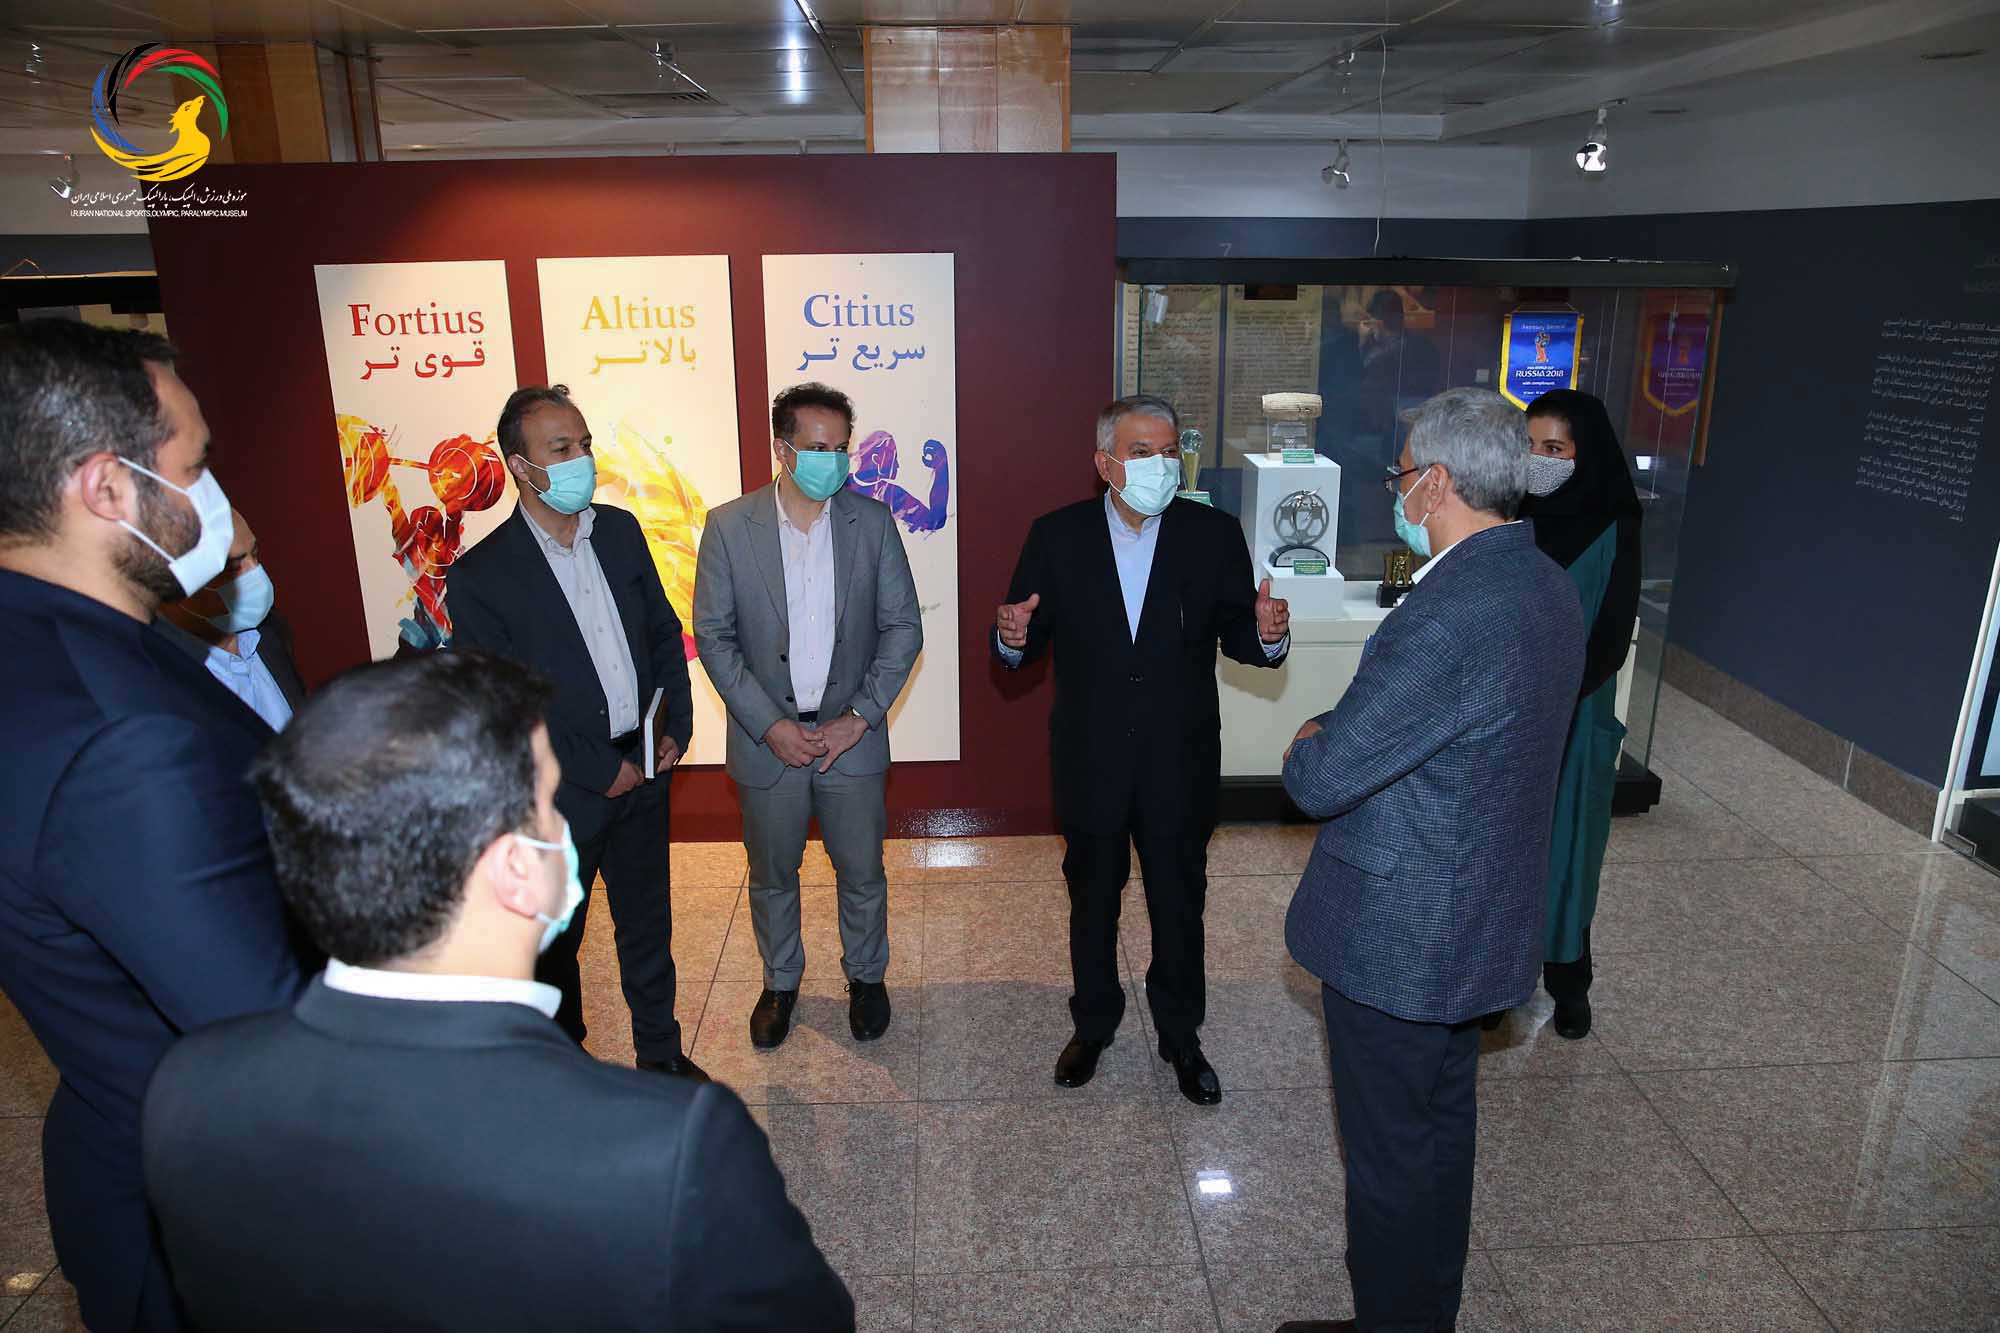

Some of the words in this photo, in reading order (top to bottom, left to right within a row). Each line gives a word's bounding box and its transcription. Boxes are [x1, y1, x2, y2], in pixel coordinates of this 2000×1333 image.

[1218, 242, 1233, 257] 7
[347, 301, 485, 337] Fortius
[583, 295, 696, 330] Altius
[803, 294, 914, 328] Citius
[359, 344, 401, 381] تر
[414, 340, 486, 379] قوی
[796, 337, 840, 371] تر
[852, 343, 926, 371] سریع
[1515, 369, 1545, 378] RUSSIA
[1545, 369, 1564, 378] 2018
